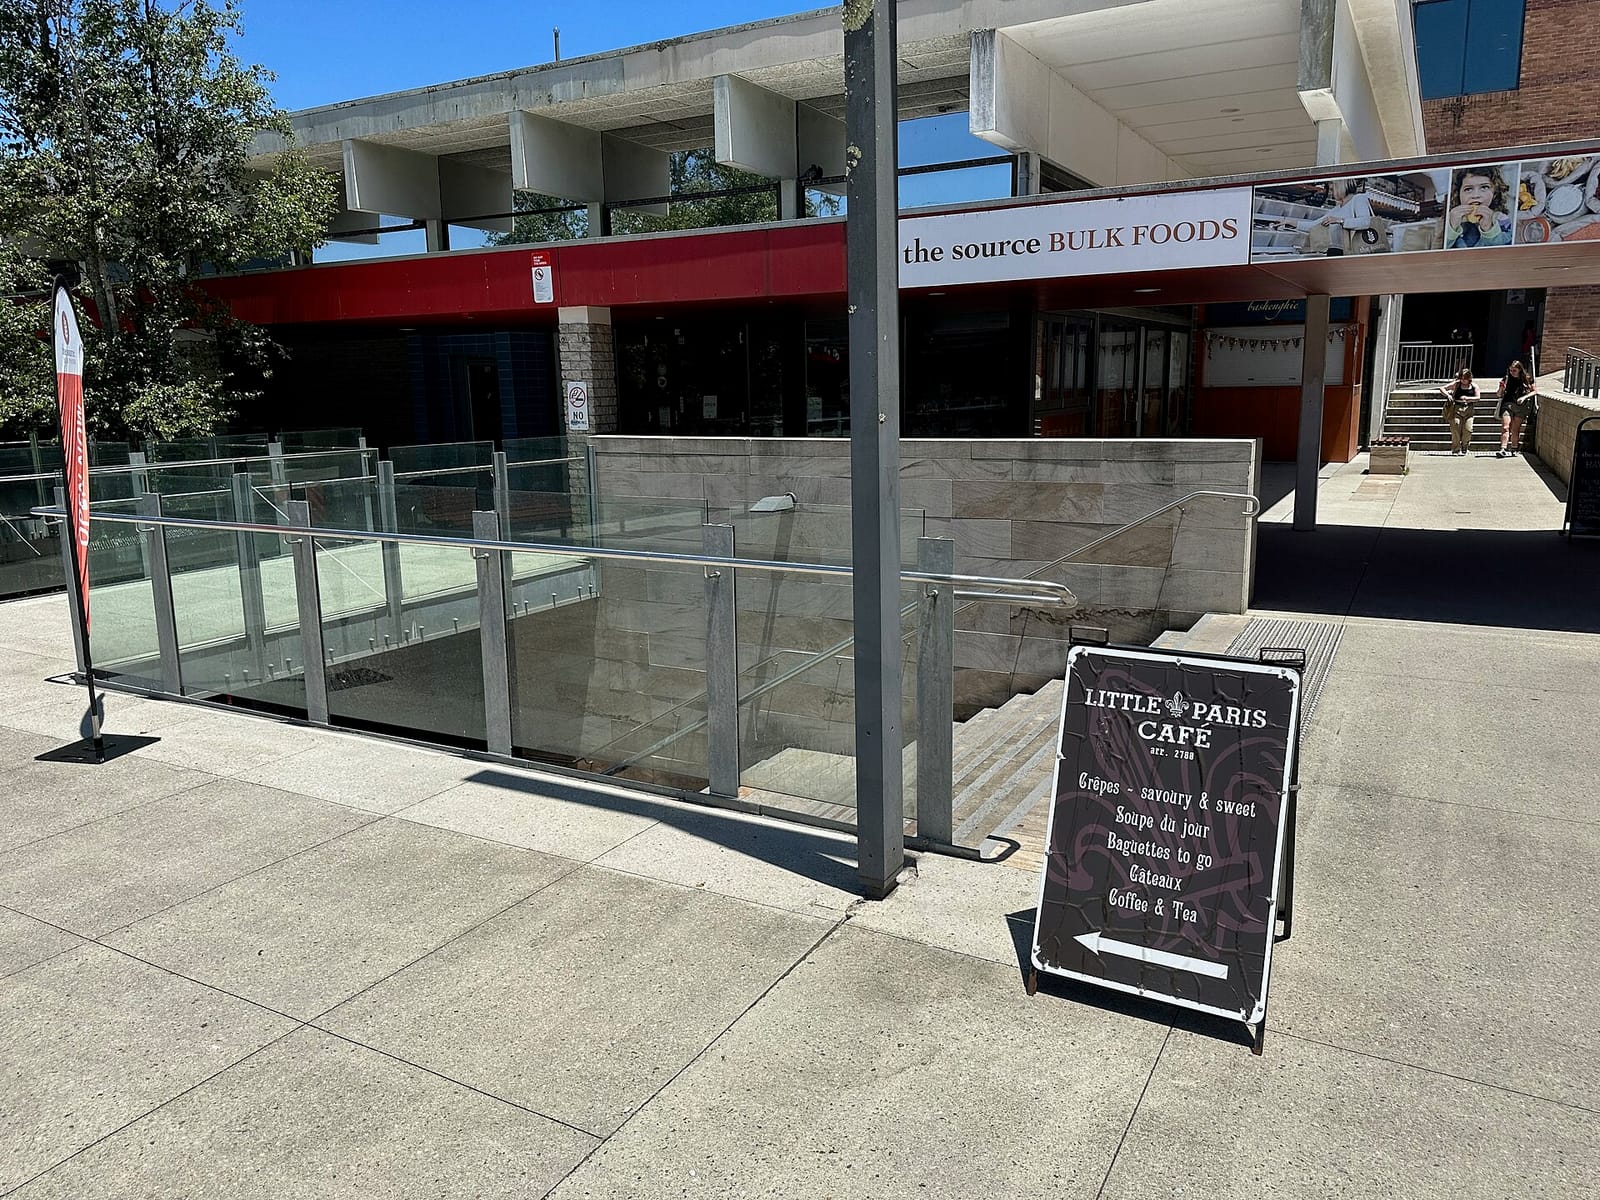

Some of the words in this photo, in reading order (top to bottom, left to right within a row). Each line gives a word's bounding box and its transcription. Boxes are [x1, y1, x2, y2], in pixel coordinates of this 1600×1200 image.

[903, 238, 944, 264] the
[951, 236, 1042, 261] source
[1048, 226, 1125, 252] BULK
[1131, 218, 1238, 245] FOODS
[573, 411, 584, 420] NO
[1084, 688, 1162, 715] LITTLE
[1191, 702, 1268, 728] PARIS
[1137, 720, 1213, 749] CAFÉ
[1150, 746, 1169, 758] arr.
[1079, 771, 1121, 796] Crêpes
[1140, 786, 1193, 811] savoury
[1199, 791, 1209, 810] &
[1215, 799, 1257, 818] sweet
[1115, 805, 1154, 832] Soupe
[1160, 814, 1176, 833] du
[1180, 817, 1210, 839] jour
[1107, 831, 1171, 861] Baguettes
[1177, 846, 1191, 864] to
[1196, 853, 1213, 871] go
[1129, 864, 1183, 892] Gâteaux
[1108, 887, 1149, 913] Coffee
[1154, 898, 1165, 916] &
[1172, 900, 1198, 923] Tea
